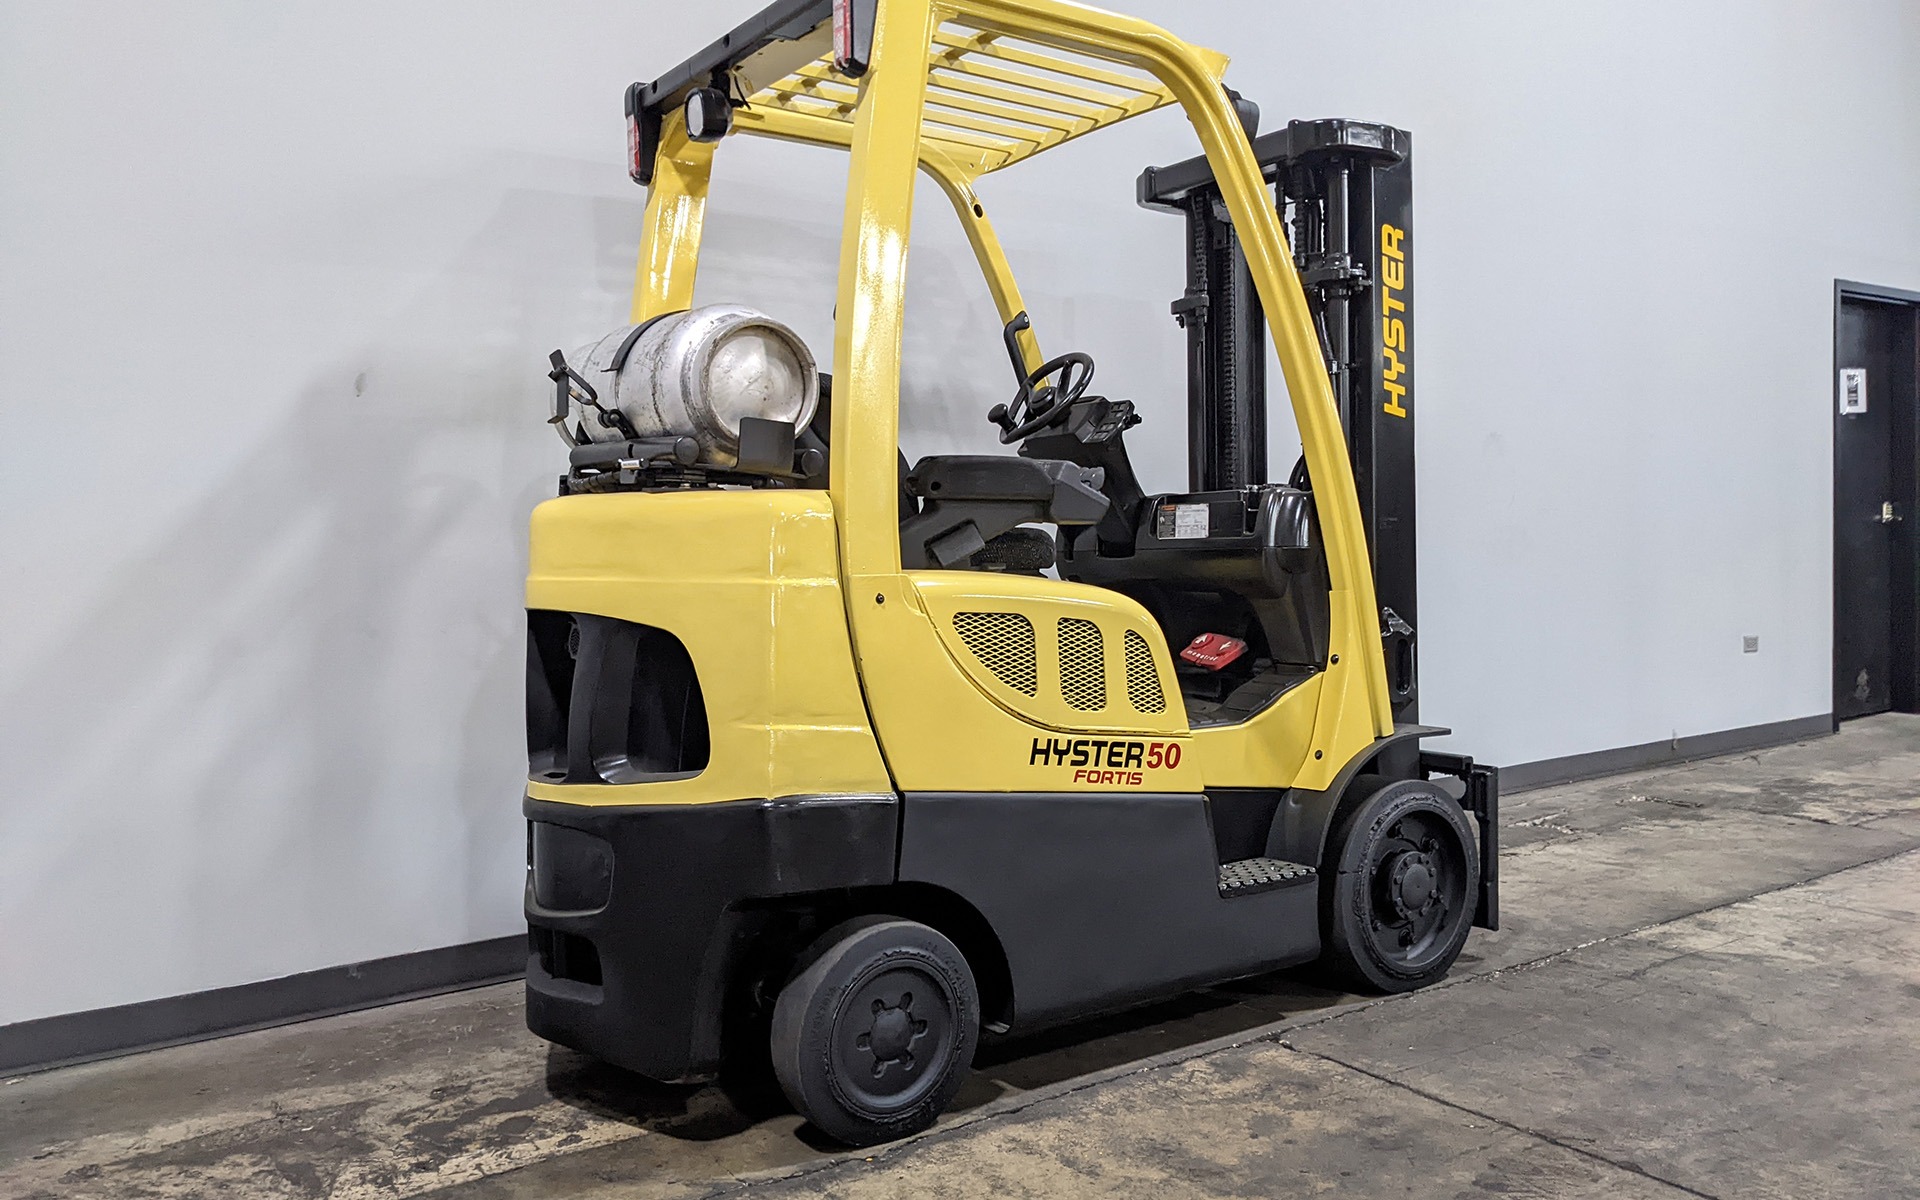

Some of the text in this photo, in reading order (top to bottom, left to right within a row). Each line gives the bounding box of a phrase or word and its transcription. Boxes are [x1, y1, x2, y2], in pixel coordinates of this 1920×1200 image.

[1382, 224, 1406, 419] HYSTER
[1030, 738, 1181, 769] HYSTER 50
[1073, 769, 1144, 785] FORTIS
